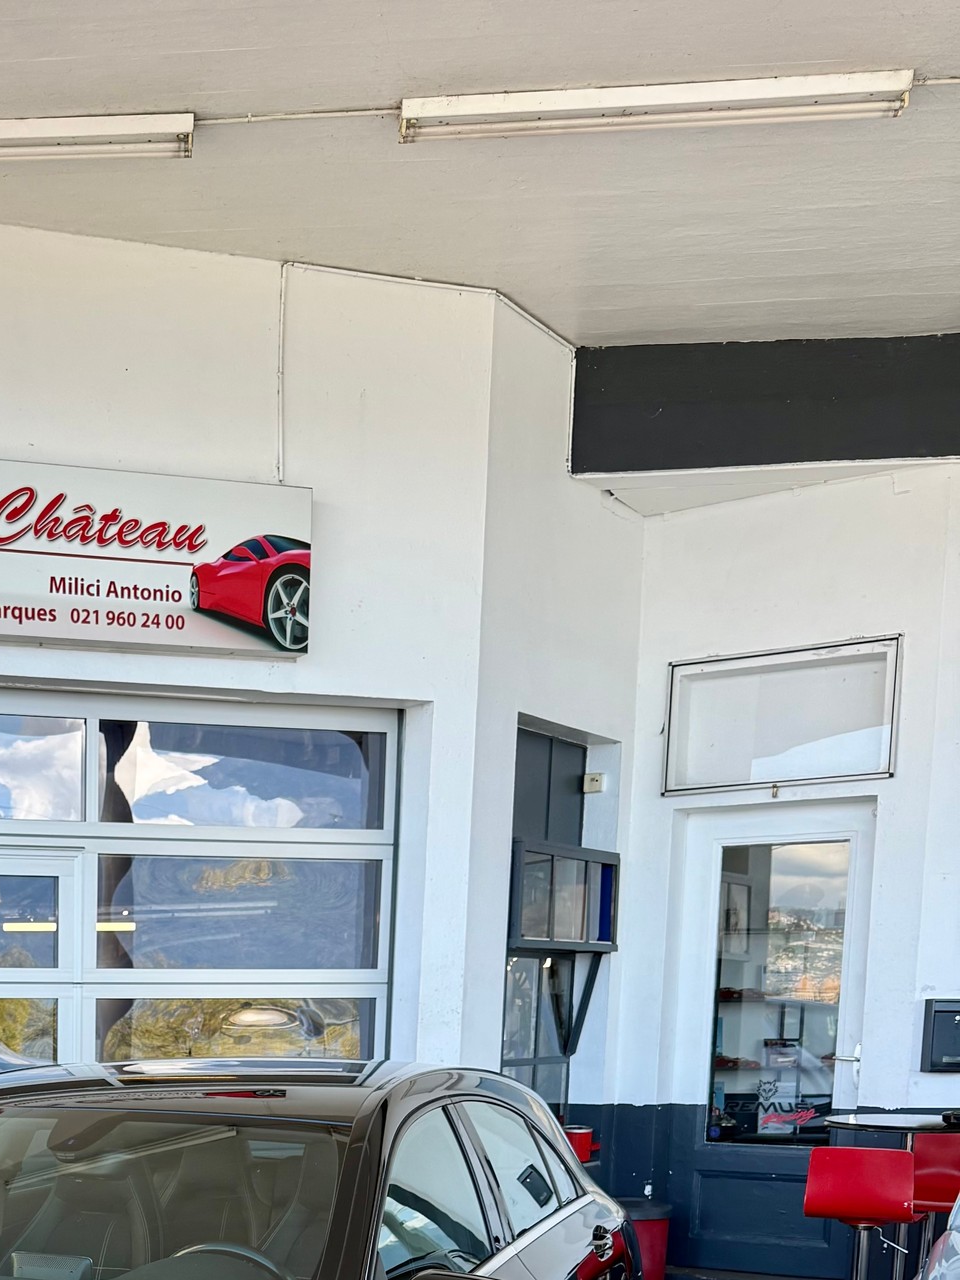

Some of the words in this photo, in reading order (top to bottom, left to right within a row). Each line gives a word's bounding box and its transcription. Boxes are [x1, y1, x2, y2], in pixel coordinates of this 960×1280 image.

[48, 575, 102, 597] Milici
[105, 580, 183, 604] Antonio
[70, 607, 100, 625] 021
[105, 610, 137, 627] 960
[140, 612, 161, 630] 24
[164, 614, 186, 631] 00
[723, 1100, 809, 1114] REMUS
